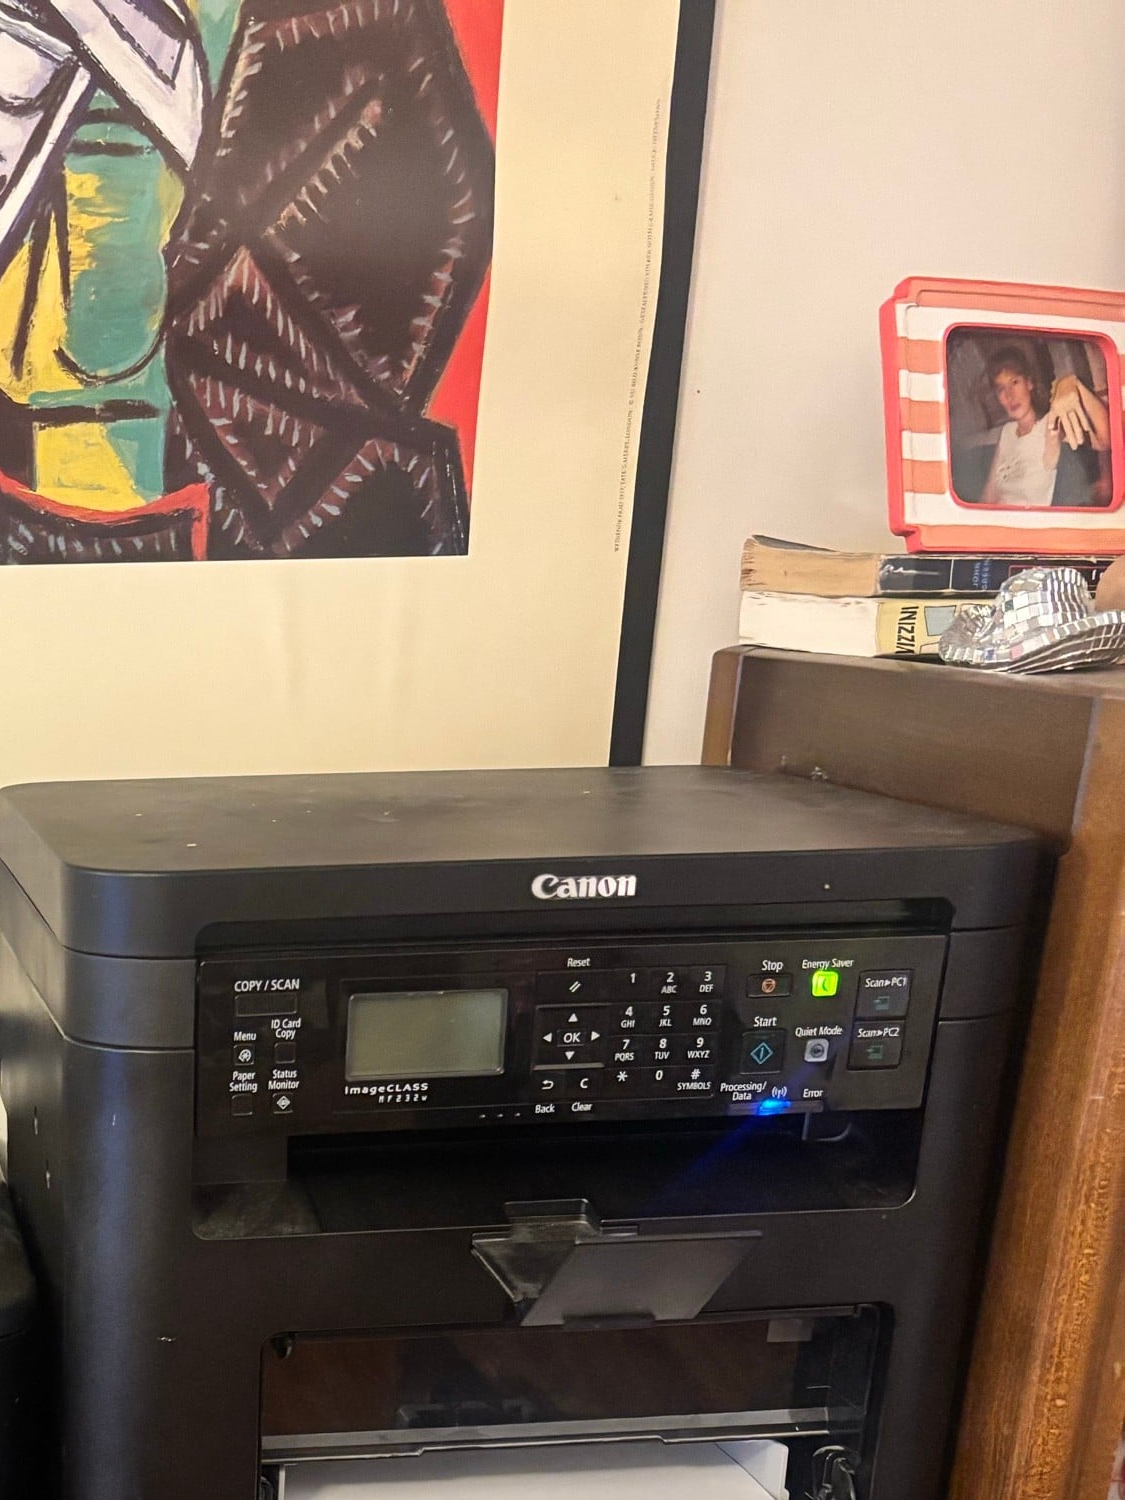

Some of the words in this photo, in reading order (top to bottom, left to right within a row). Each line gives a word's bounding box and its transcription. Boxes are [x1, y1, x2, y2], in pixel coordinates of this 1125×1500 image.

[894, 605, 919, 654] VIZZINI
[532, 874, 636, 899] Canon
[567, 958, 591, 967] Reset
[762, 960, 783, 973] Stop
[802, 959, 829, 970] Energy
[832, 959, 854, 967] Saver
[630, 973, 636, 983] 1
[667, 972, 674, 982] 2
[704, 972, 712, 981] 3
[235, 981, 263, 992] COPY
[271, 979, 300, 990] SCAN
[661, 985, 677, 993] ABC
[699, 984, 714, 992] DEF
[625, 1006, 633, 1016] 4
[663, 1006, 671, 1015] 5
[700, 1005, 707, 1014] 6
[271, 1019, 280, 1029] ID
[282, 1018, 301, 1028] Card
[621, 1020, 635, 1028] GHI
[659, 1019, 672, 1027] JKL
[693, 1018, 712, 1026] MNO
[754, 1016, 777, 1027] Start
[234, 1032, 256, 1040] Menu
[276, 1029, 296, 1040] Copy
[795, 1028, 817, 1037] Quiet
[819, 1026, 843, 1035] Mode
[563, 1033, 580, 1043] OK
[696, 1038, 704, 1047] 9
[623, 1039, 630, 1049] 7
[659, 1039, 667, 1048] 8
[615, 1052, 634, 1061] PQRS
[233, 1071, 255, 1082] Paper
[273, 1069, 297, 1079] Status
[655, 1070, 663, 1080] 0
[229, 1082, 257, 1093] Setting
[268, 1080, 300, 1090] Monitor
[677, 1082, 712, 1090] SYMBOLS
[720, 1081, 767, 1092] Processing/
[733, 1092, 752, 1101] Data
[803, 1089, 823, 1098] Error
[535, 1104, 555, 1113] Back
[572, 1102, 593, 1112] Clear
